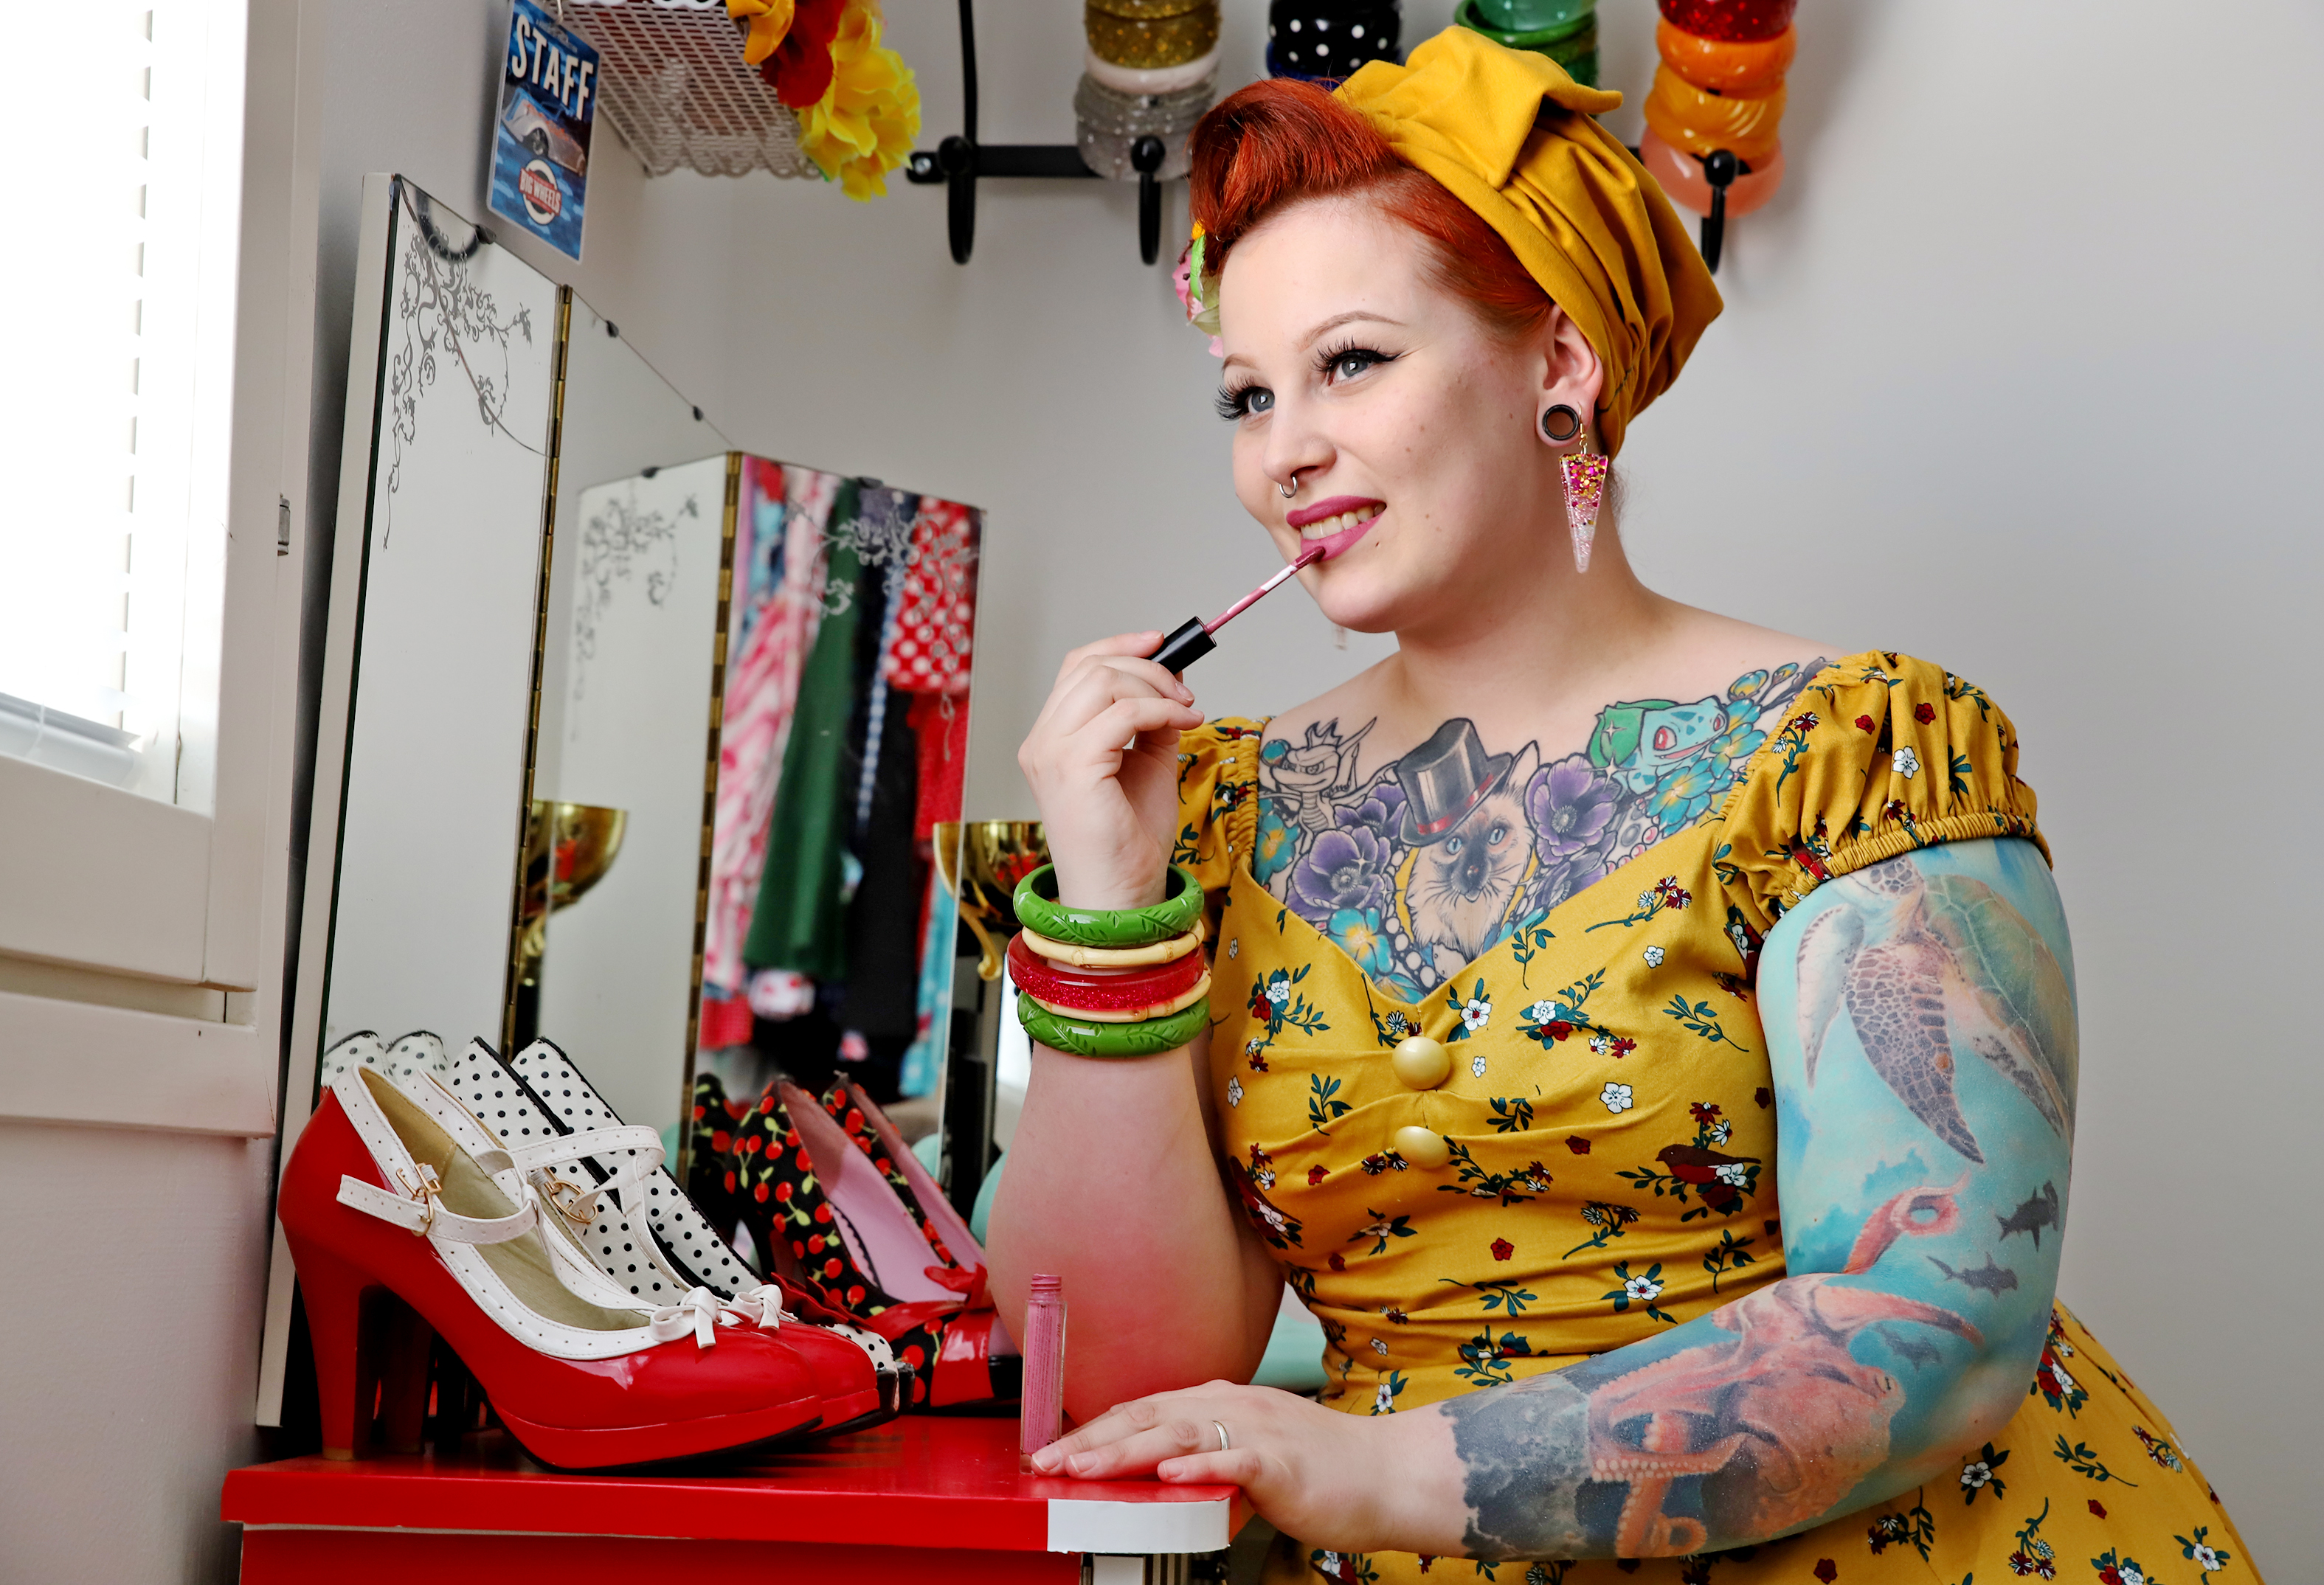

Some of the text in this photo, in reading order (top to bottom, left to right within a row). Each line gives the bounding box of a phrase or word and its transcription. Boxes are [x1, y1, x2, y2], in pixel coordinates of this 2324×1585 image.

[511, 14, 593, 121] STAFF
[519, 169, 561, 214] BIG WHEELS
